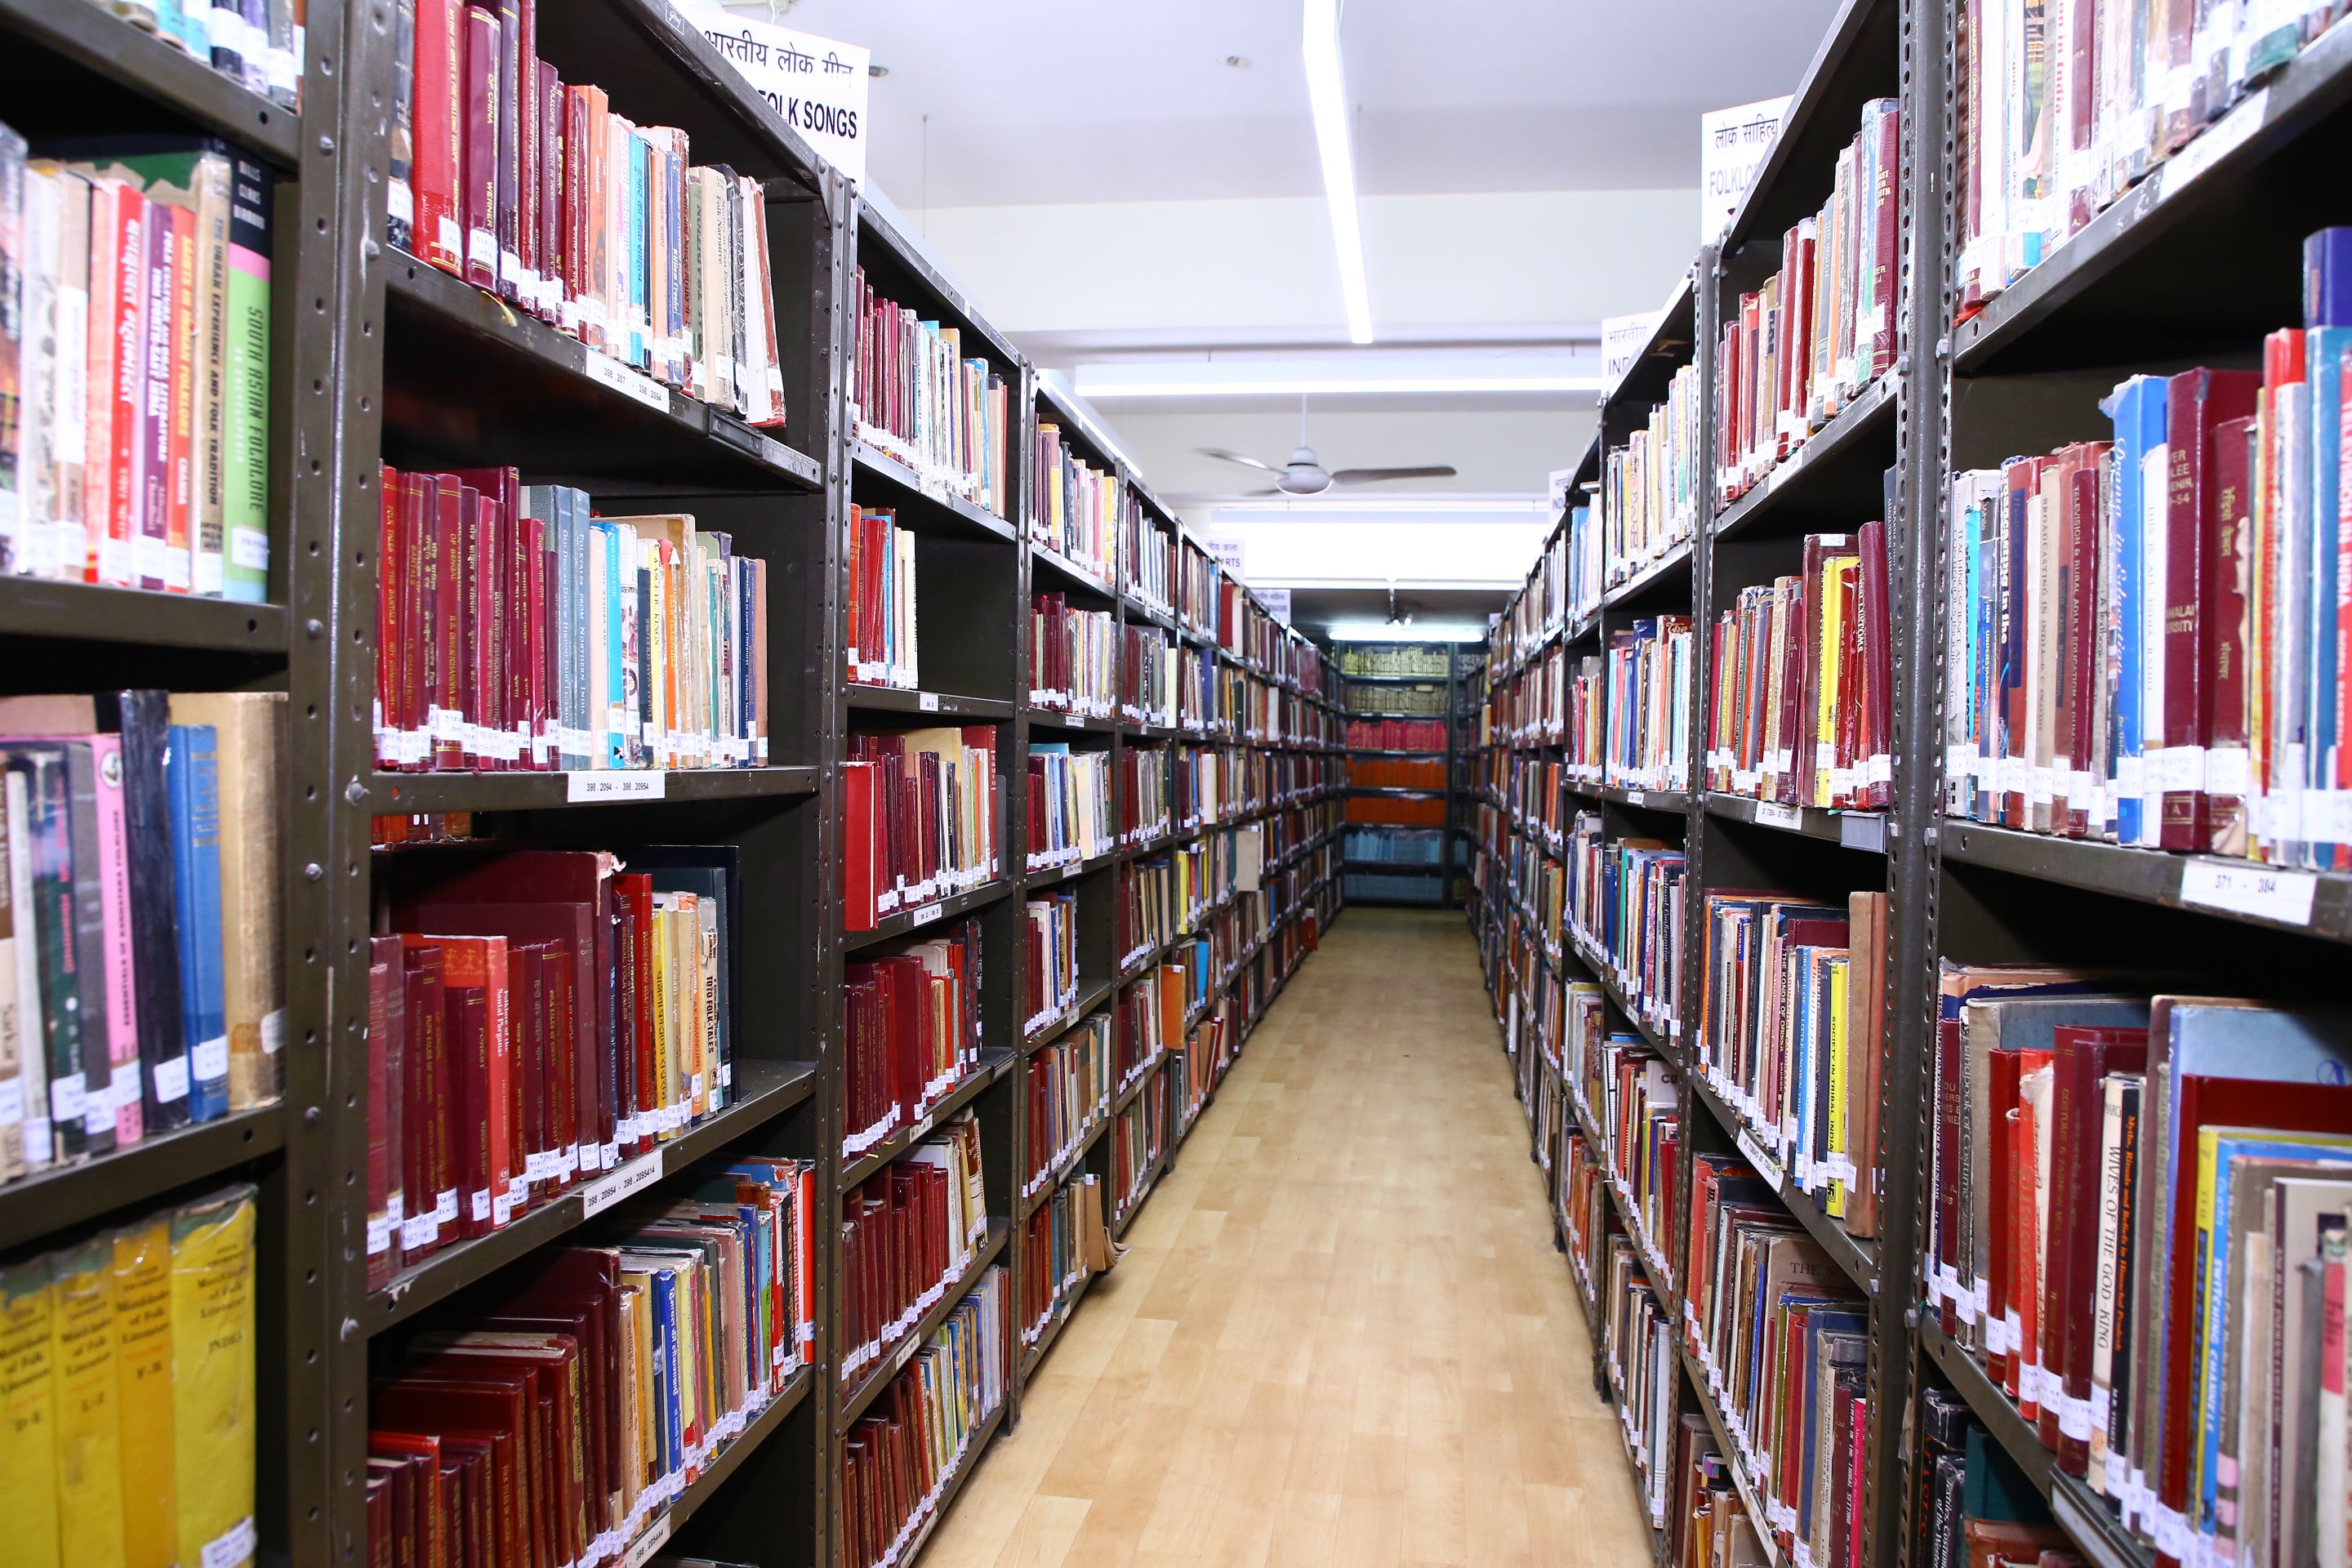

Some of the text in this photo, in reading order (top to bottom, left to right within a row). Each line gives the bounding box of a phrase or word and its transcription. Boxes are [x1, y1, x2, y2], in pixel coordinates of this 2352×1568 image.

[776, 42, 815, 74] लोक
[2057, 35, 2066, 54] in
[488, 74, 493, 89] OF
[2056, 61, 2065, 114] India
[758, 90, 858, 139] OLK SONGS
[1715, 114, 1779, 149] लोक साहित्य
[1710, 163, 1757, 197] FOLKLO
[163, 230, 173, 265] FOLK
[212, 246, 222, 289] URBAN
[177, 234, 193, 437] SAINTS IN INDIAN FOLKLORE
[211, 293, 221, 365] EXPERIENCE
[148, 379, 159, 416] INDIA
[210, 370, 220, 397] AND
[638, 383, 662, 402] 398.2094
[209, 402, 219, 431] FOLK
[247, 305, 265, 511] SOUTH ASIAN FOLKLORE
[209, 438, 218, 506] TRADITION
[2336, 399, 2352, 608] TELEVISION IN INDIA
[451, 533, 457, 544] OF
[2116, 438, 2127, 675] Drama in Education
[2002, 590, 2009, 611] in
[2041, 601, 2047, 615] IN
[2001, 613, 2009, 644] the
[2097, 610, 2108, 657] Textbook
[586, 782, 612, 792] 398.2094
[622, 782, 649, 792] 398.20954
[2215, 875, 2234, 890] 371
[2258, 879, 2277, 893] 384
[1780, 1005, 1786, 1018] OF
[1801, 991, 1806, 1005] OF
[495, 1018, 504, 1058] Parganas
[1809, 1017, 1815, 1030] of
[1830, 1063, 1836, 1075] IN
[1963, 1116, 1971, 1132] of
[2059, 1088, 2070, 1143] COSTUME
[1962, 1134, 1971, 1200] Costume
[587, 1183, 617, 1208] 398.20954
[623, 1165, 656, 1190] 398.2095414
[2097, 1145, 2122, 1350] WIVES OF THE GOD-KING
[2114, 1115, 2136, 1352] Myths, Rituals and Beliefs in Himachal Pradesh
[1789, 1263, 1818, 1276] THE
[670, 1329, 677, 1343] की
[2205, 1258, 2224, 1433] SWITCHING CHANNELS
[1936, 1498, 1944, 1512] of
[1943, 1480, 1953, 1521] Textiles,
[1936, 1512, 1944, 1530] the
[635, 1528, 665, 1561] 398.205444
